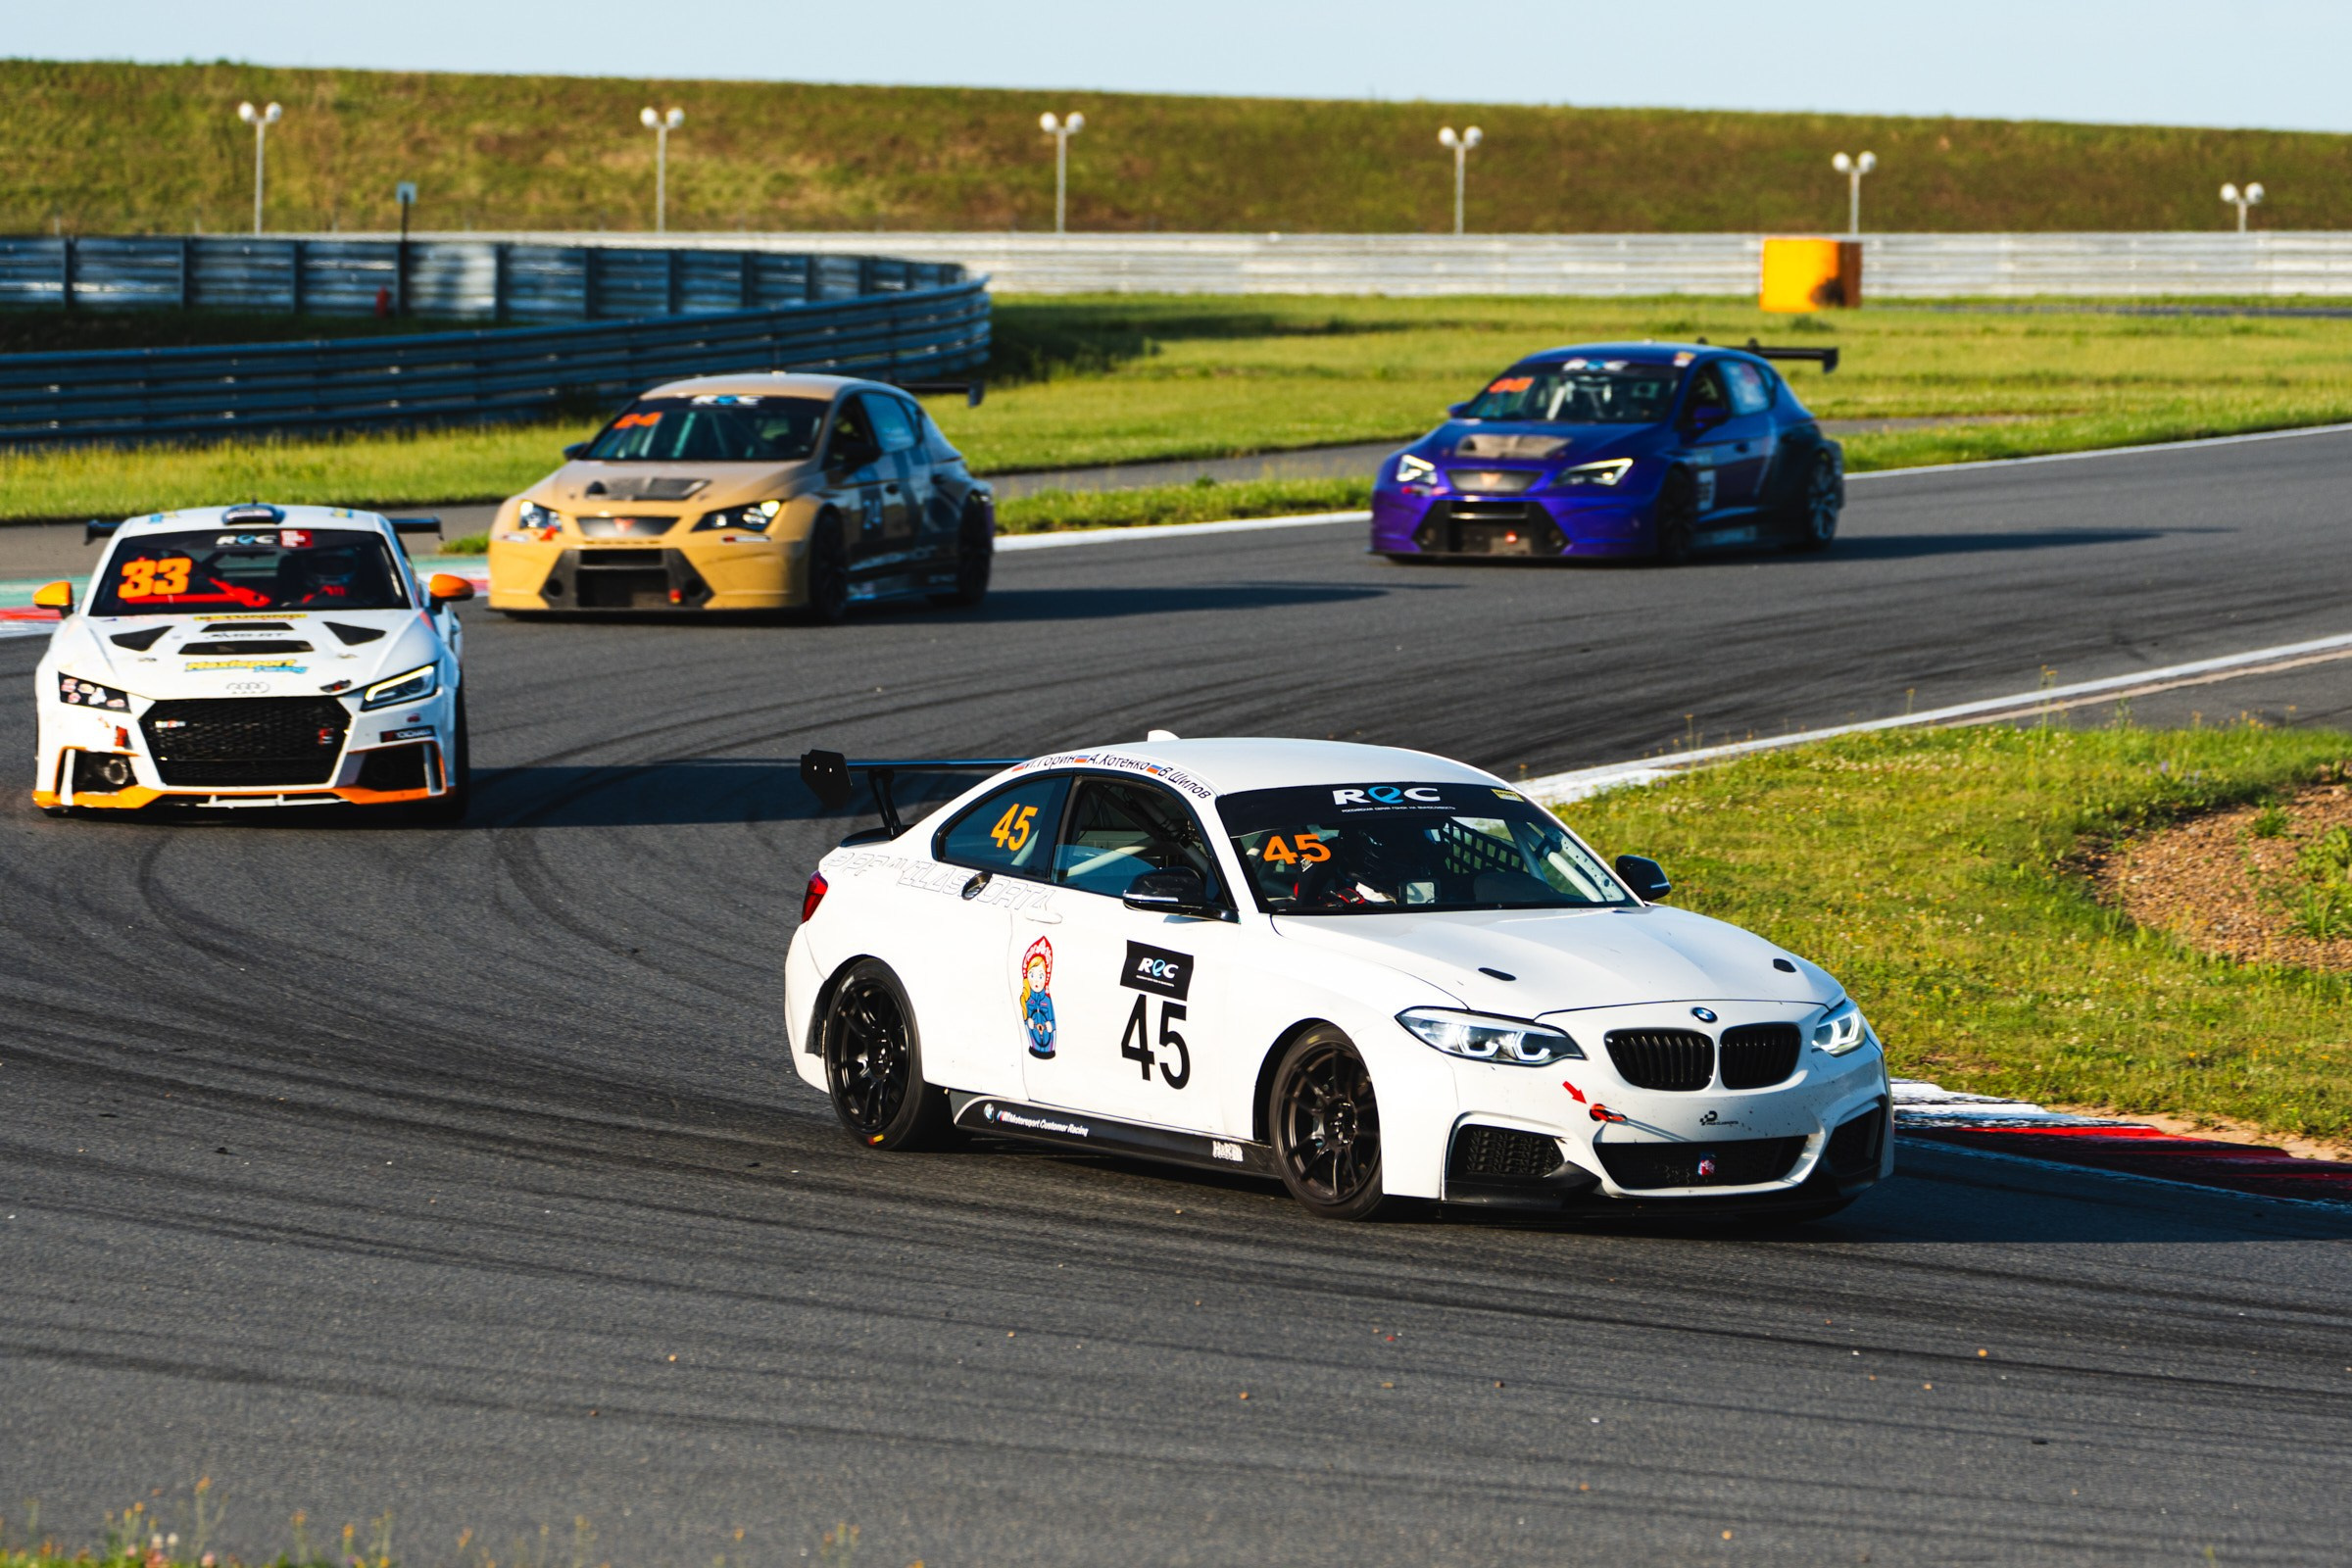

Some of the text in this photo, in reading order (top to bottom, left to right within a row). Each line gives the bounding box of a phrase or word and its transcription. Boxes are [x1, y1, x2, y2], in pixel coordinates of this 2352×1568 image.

[118, 557, 192, 599] 33
[990, 803, 1039, 852] 45
[1263, 833, 1332, 864] 45
[1121, 993, 1191, 1090] 45
